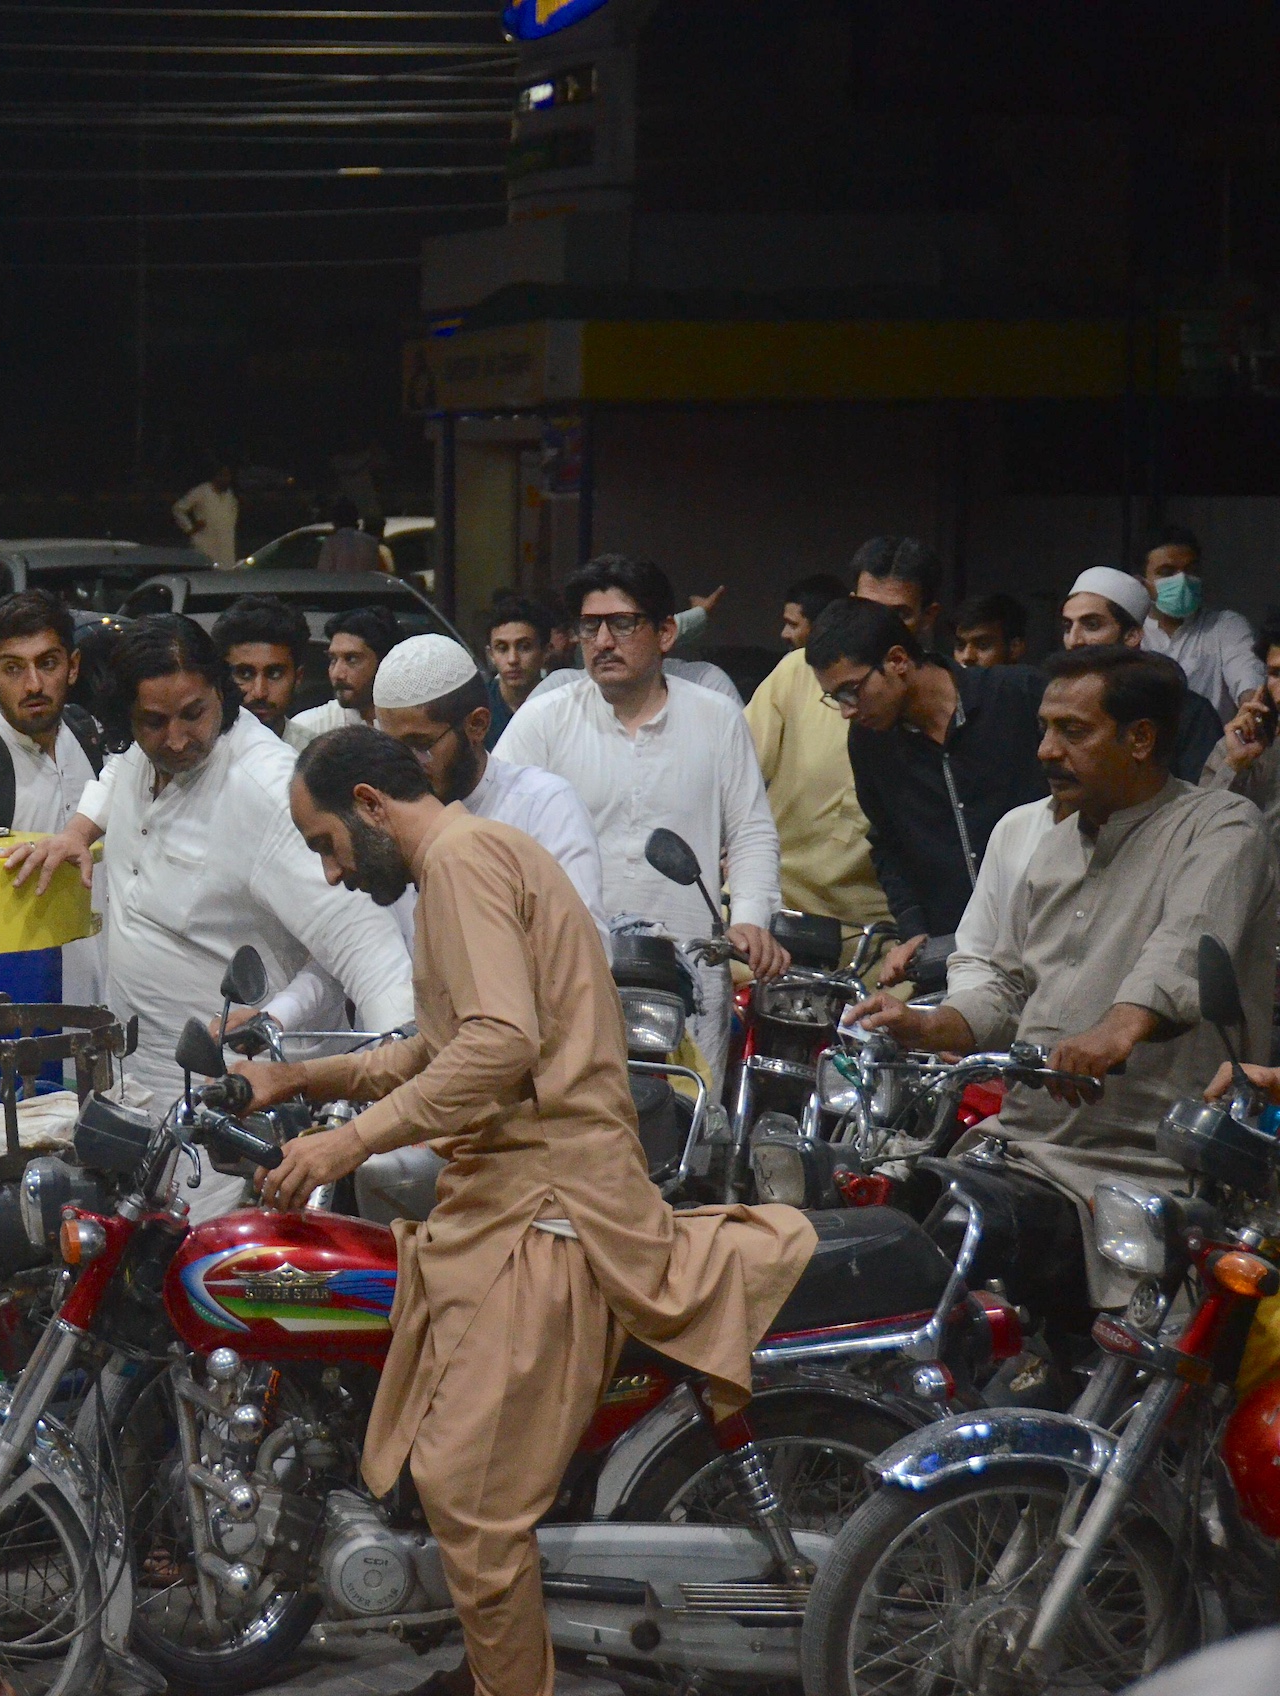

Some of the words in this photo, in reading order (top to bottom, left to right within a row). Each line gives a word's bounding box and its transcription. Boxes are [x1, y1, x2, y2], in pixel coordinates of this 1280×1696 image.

[244, 1288, 291, 1299] SUPER
[293, 1288, 330, 1299] STAR
[363, 1557, 389, 1566] CDI
[346, 1582, 371, 1607] SUPER
